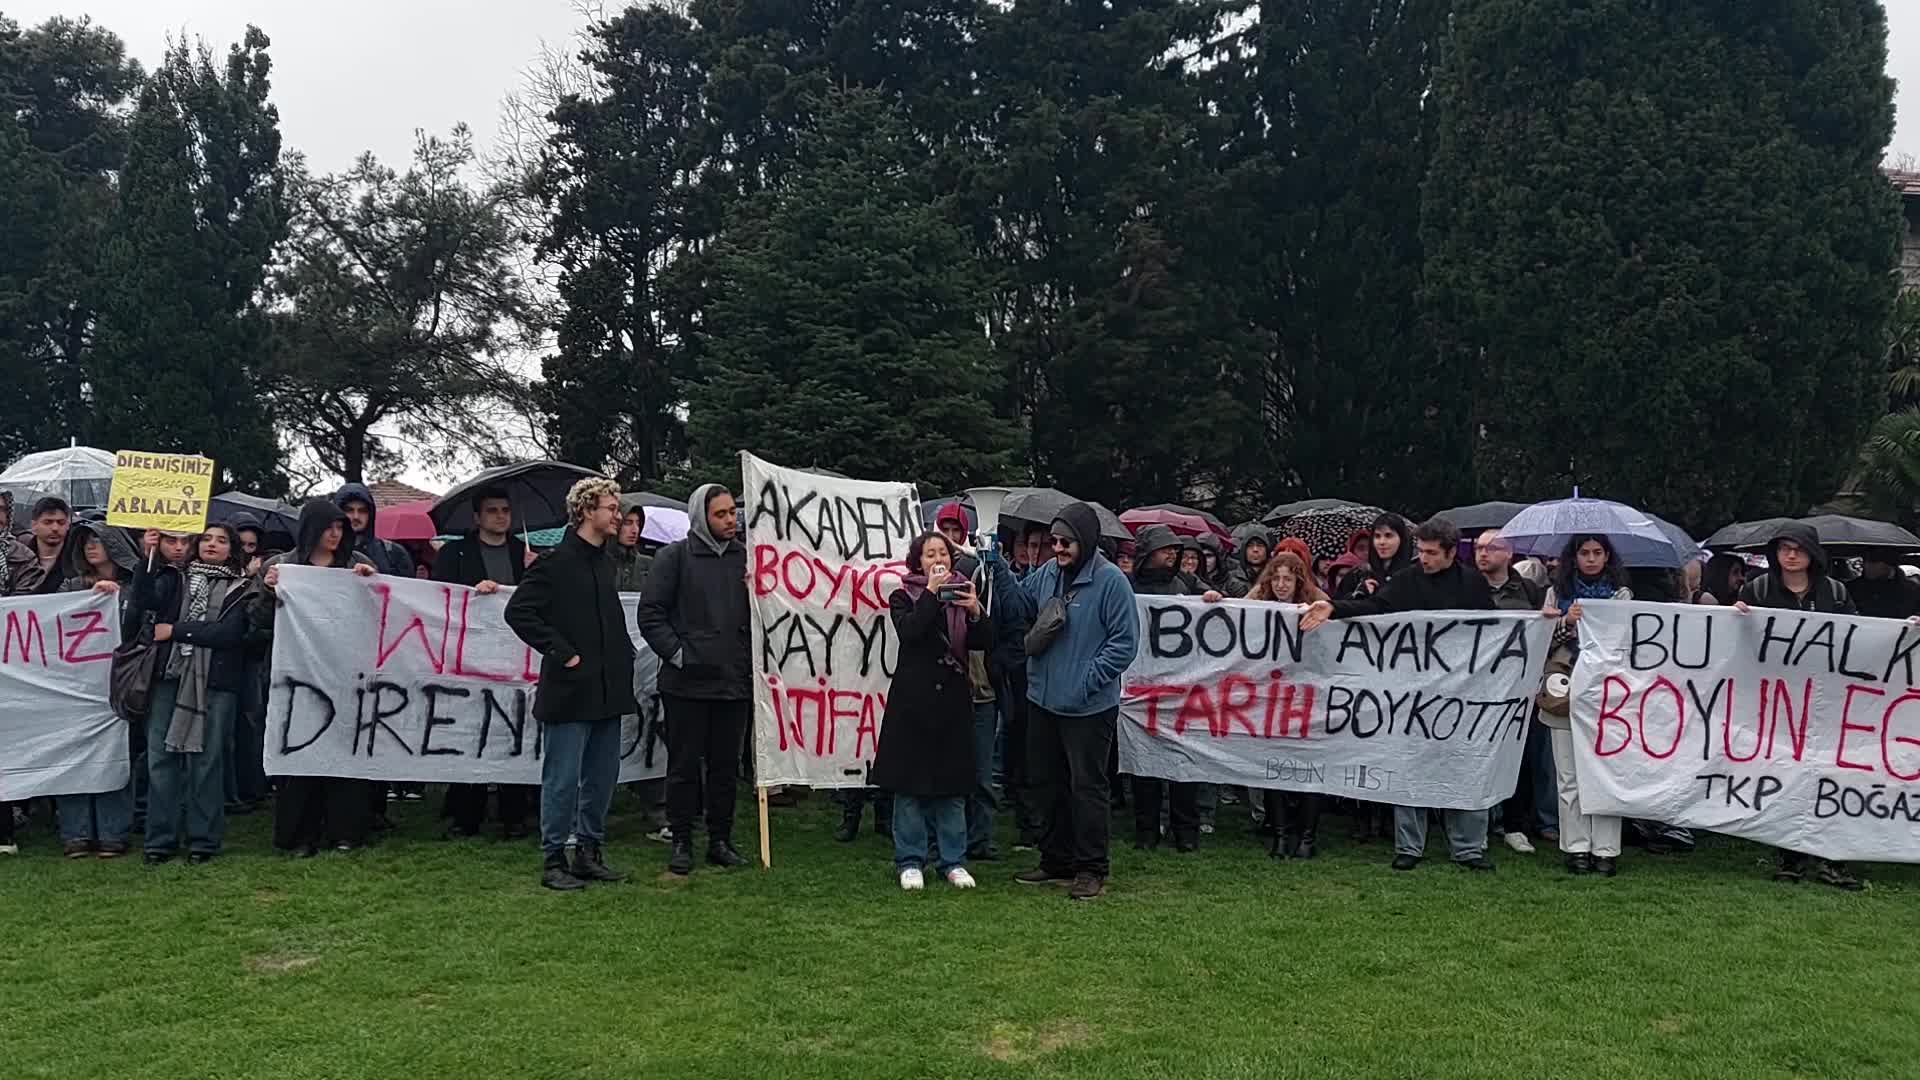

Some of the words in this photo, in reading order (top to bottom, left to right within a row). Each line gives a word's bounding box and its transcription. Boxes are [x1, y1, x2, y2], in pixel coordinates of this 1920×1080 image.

[112, 496, 203, 515] ABLALAR
[754, 544, 907, 614] BOYKO
[1149, 605, 1304, 663] BOUN
[1335, 619, 1528, 678] AYAKTA
[1630, 613, 1712, 669] BU
[1758, 616, 1920, 685] HALK
[1127, 669, 1317, 738] TARİH
[1326, 685, 1531, 741] BOYKOTTA
[1595, 675, 1812, 761] BOYUN
[1265, 756, 1326, 784] BOUN
[1343, 764, 1398, 791] HIST
[1696, 773, 1783, 811] TKP
